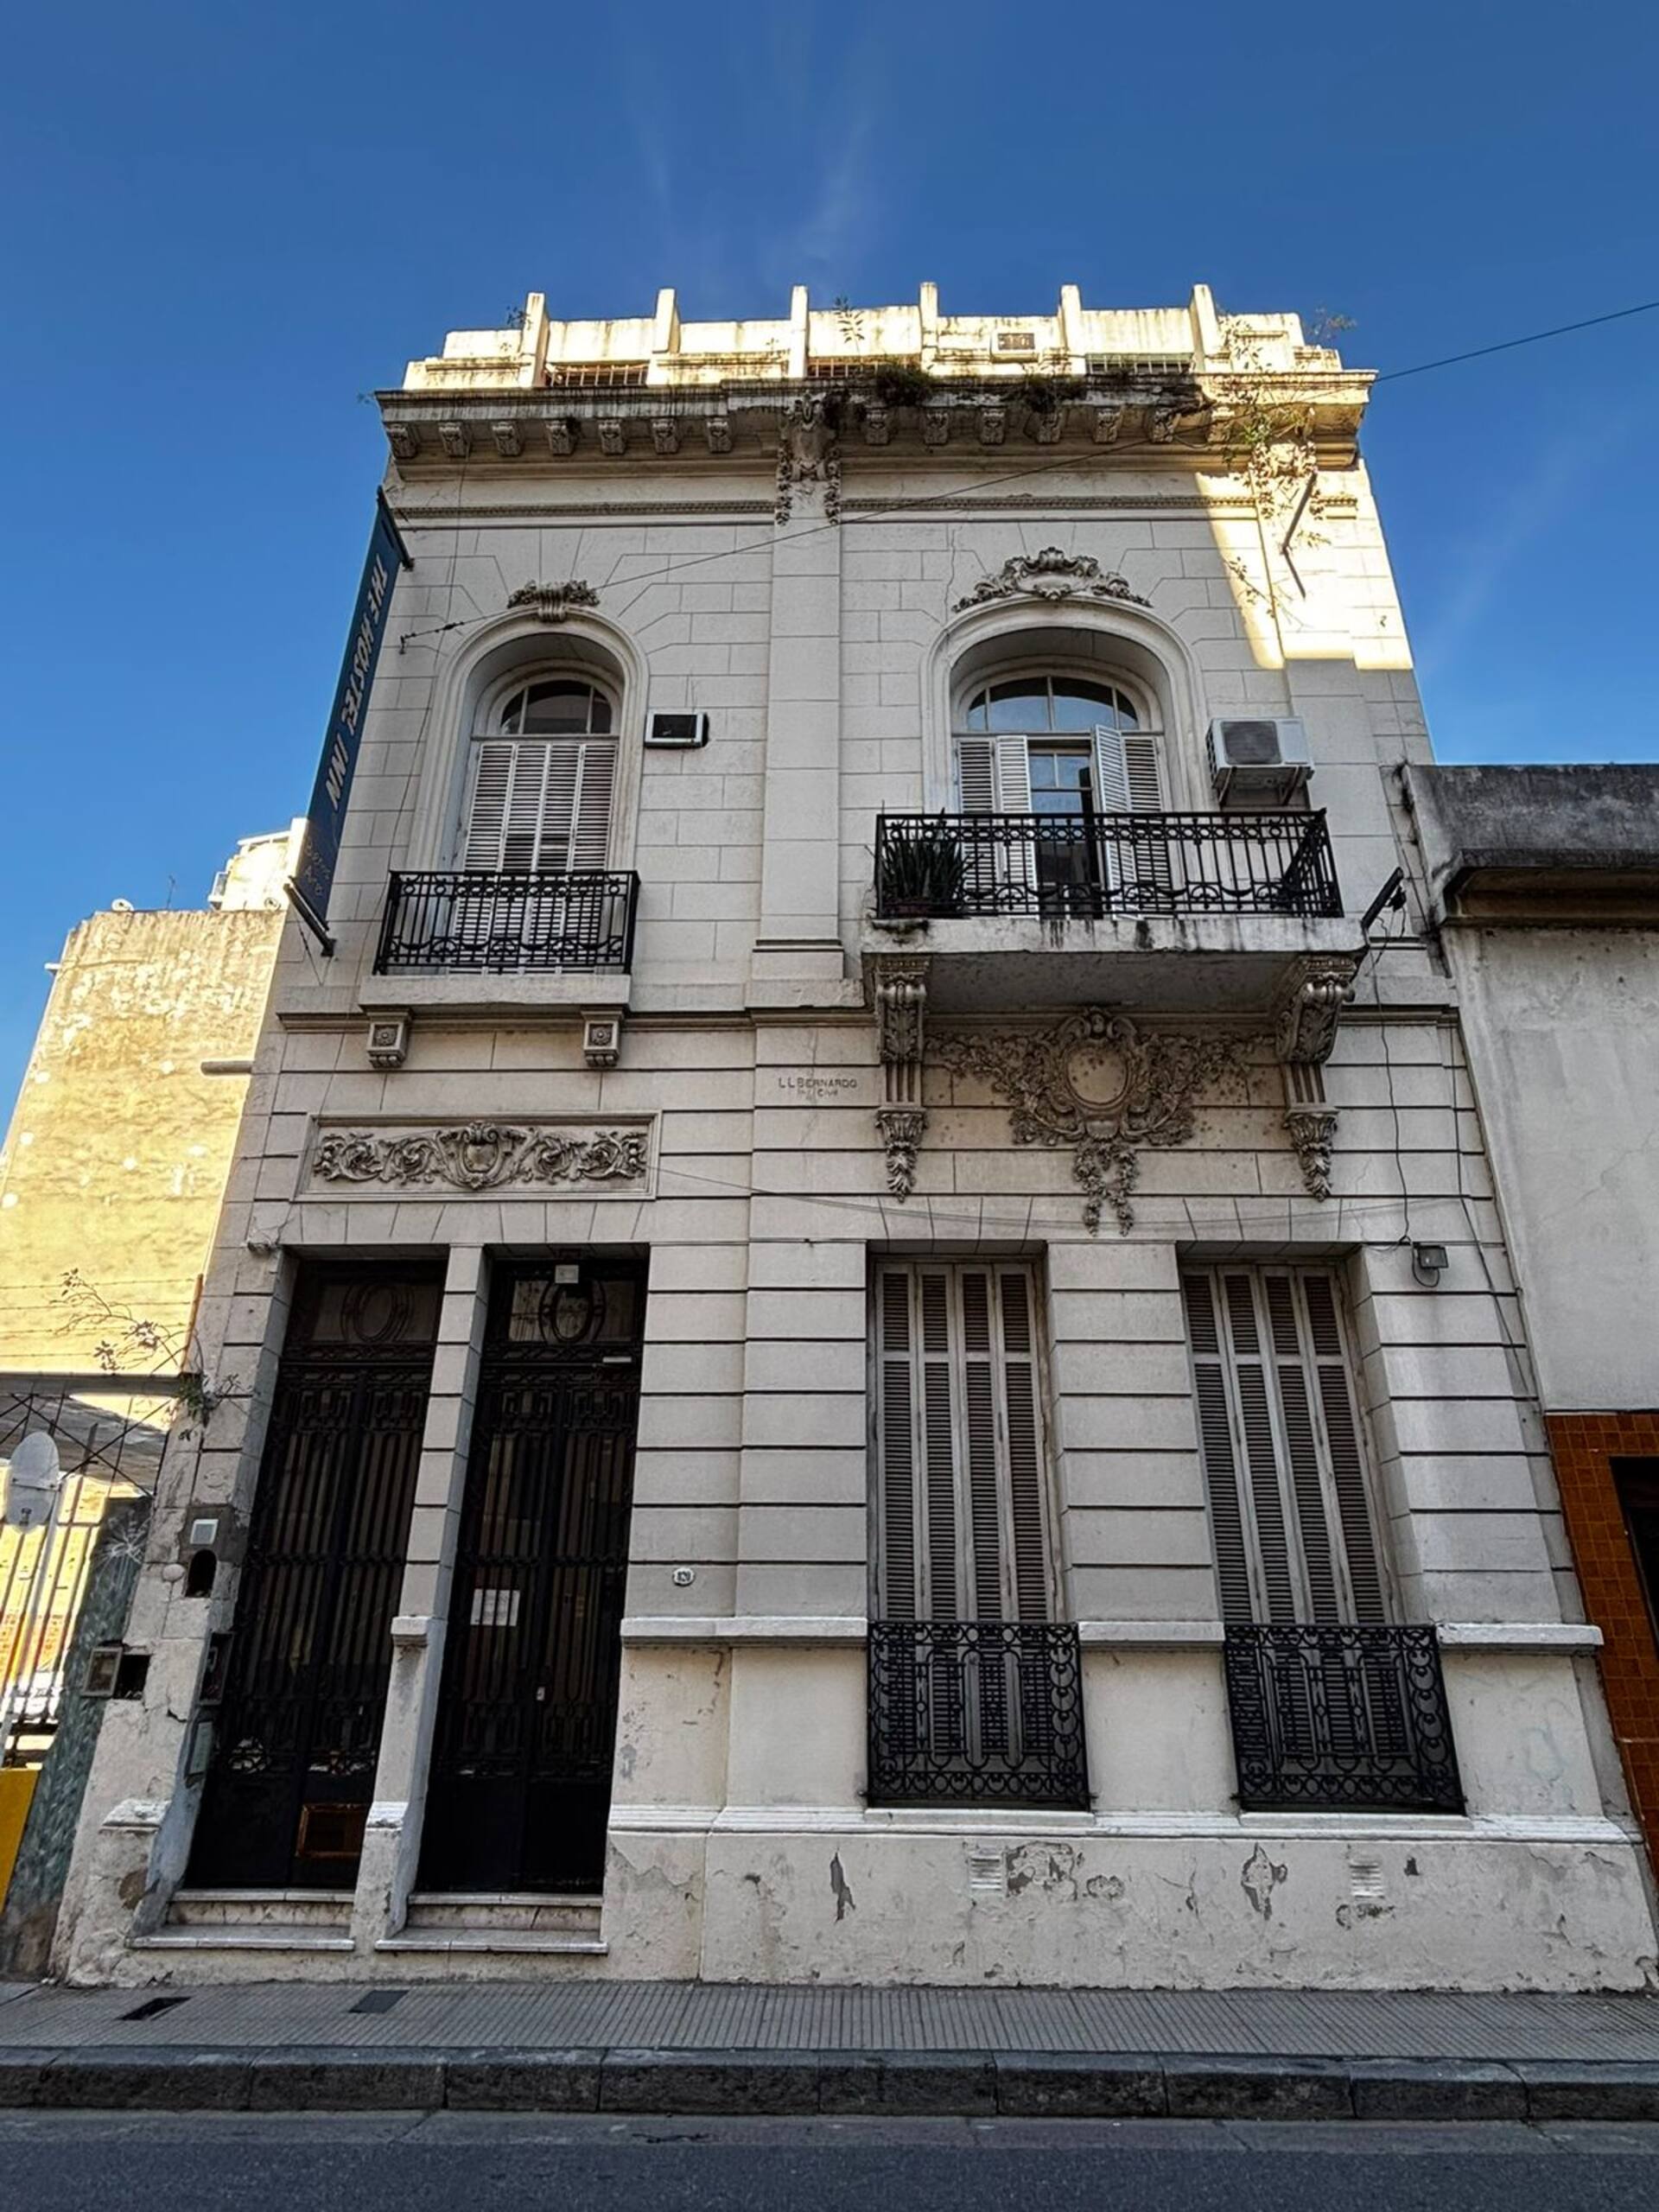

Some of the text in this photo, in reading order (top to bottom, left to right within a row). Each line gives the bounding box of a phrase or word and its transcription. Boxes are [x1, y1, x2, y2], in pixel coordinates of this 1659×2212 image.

[325, 553, 389, 810] THE HOSTEL INN
